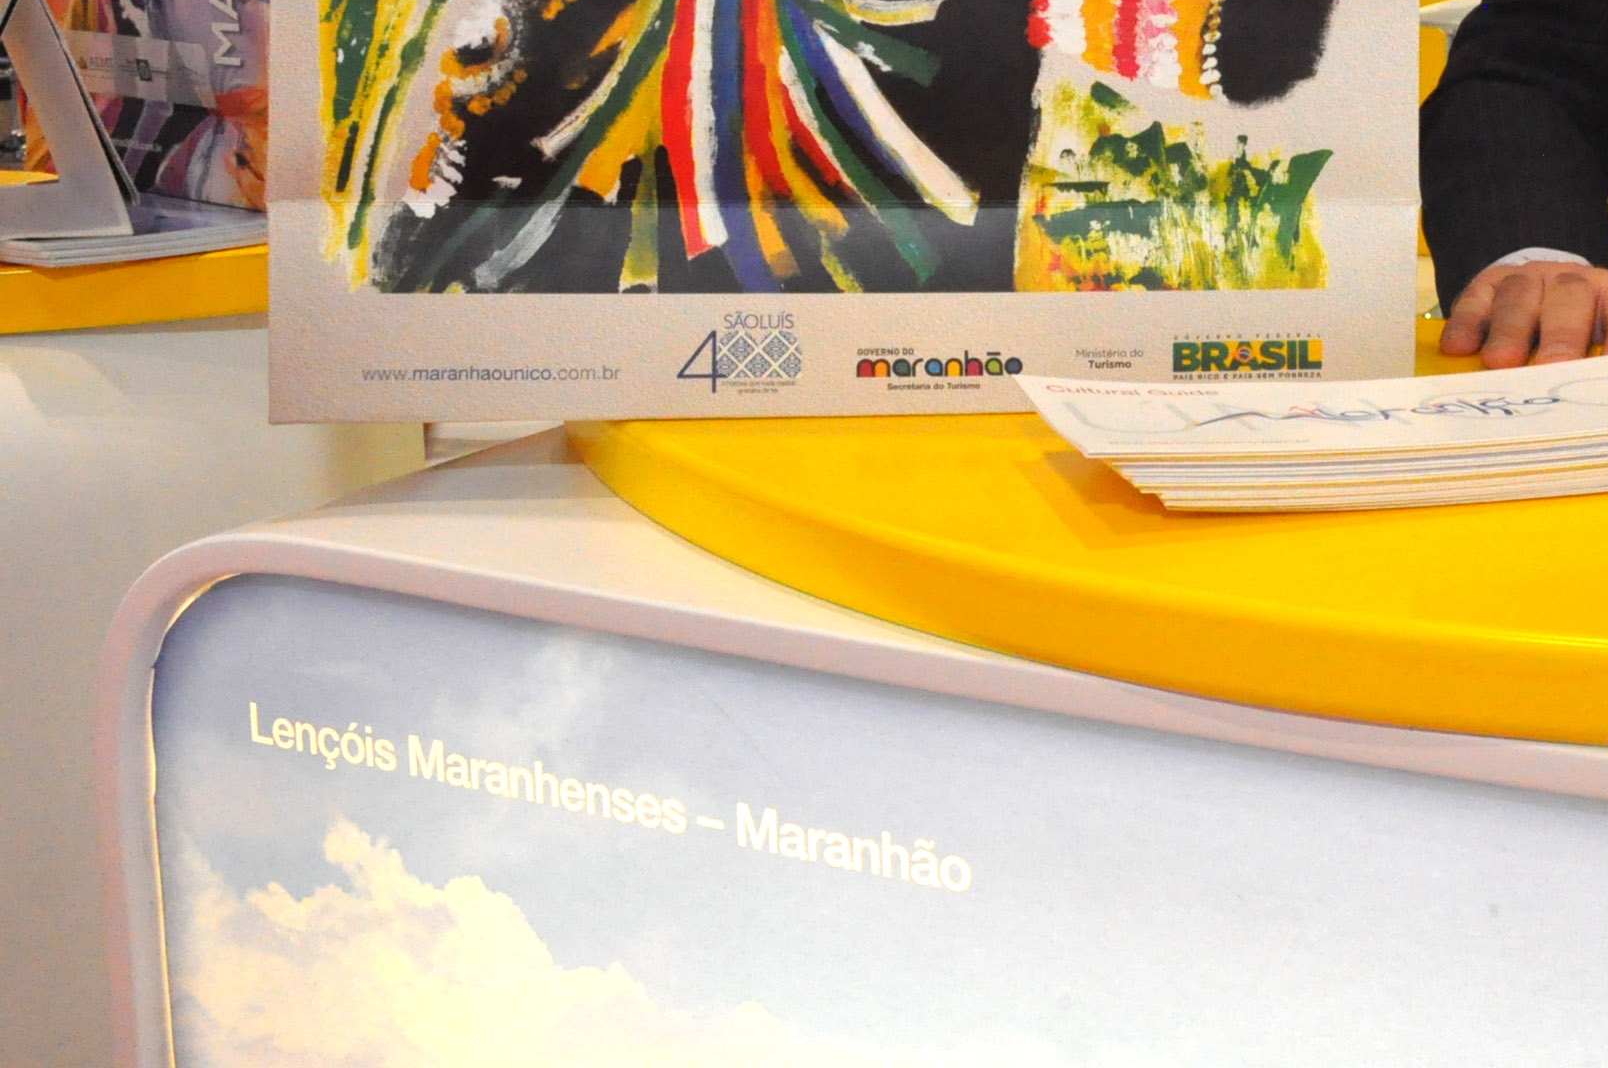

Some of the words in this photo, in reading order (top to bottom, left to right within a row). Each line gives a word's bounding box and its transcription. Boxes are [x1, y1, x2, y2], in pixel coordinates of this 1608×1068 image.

[856, 347, 900, 356] GOVERNO
[902, 347, 915, 356] DO
[1076, 348, 1132, 358] Ministério
[1134, 348, 1144, 358] do
[1172, 339, 1323, 372] BRASIL
[1088, 359, 1133, 369] Turismo
[361, 365, 621, 383] www.maranhaounico.com.br
[1197, 373, 1219, 381] RICO
[1257, 371, 1275, 379] SEM
[1278, 371, 1322, 379] POBREZA
[887, 382, 931, 391] Secretaria
[933, 382, 945, 390] do
[947, 382, 981, 390] Turismo
[1046, 383, 1140, 397] Cultural
[1147, 387, 1219, 397] Guide
[248, 701, 398, 770] Lençóis
[407, 733, 687, 834] Maranhenses
[736, 802, 972, 893] Maranhão
